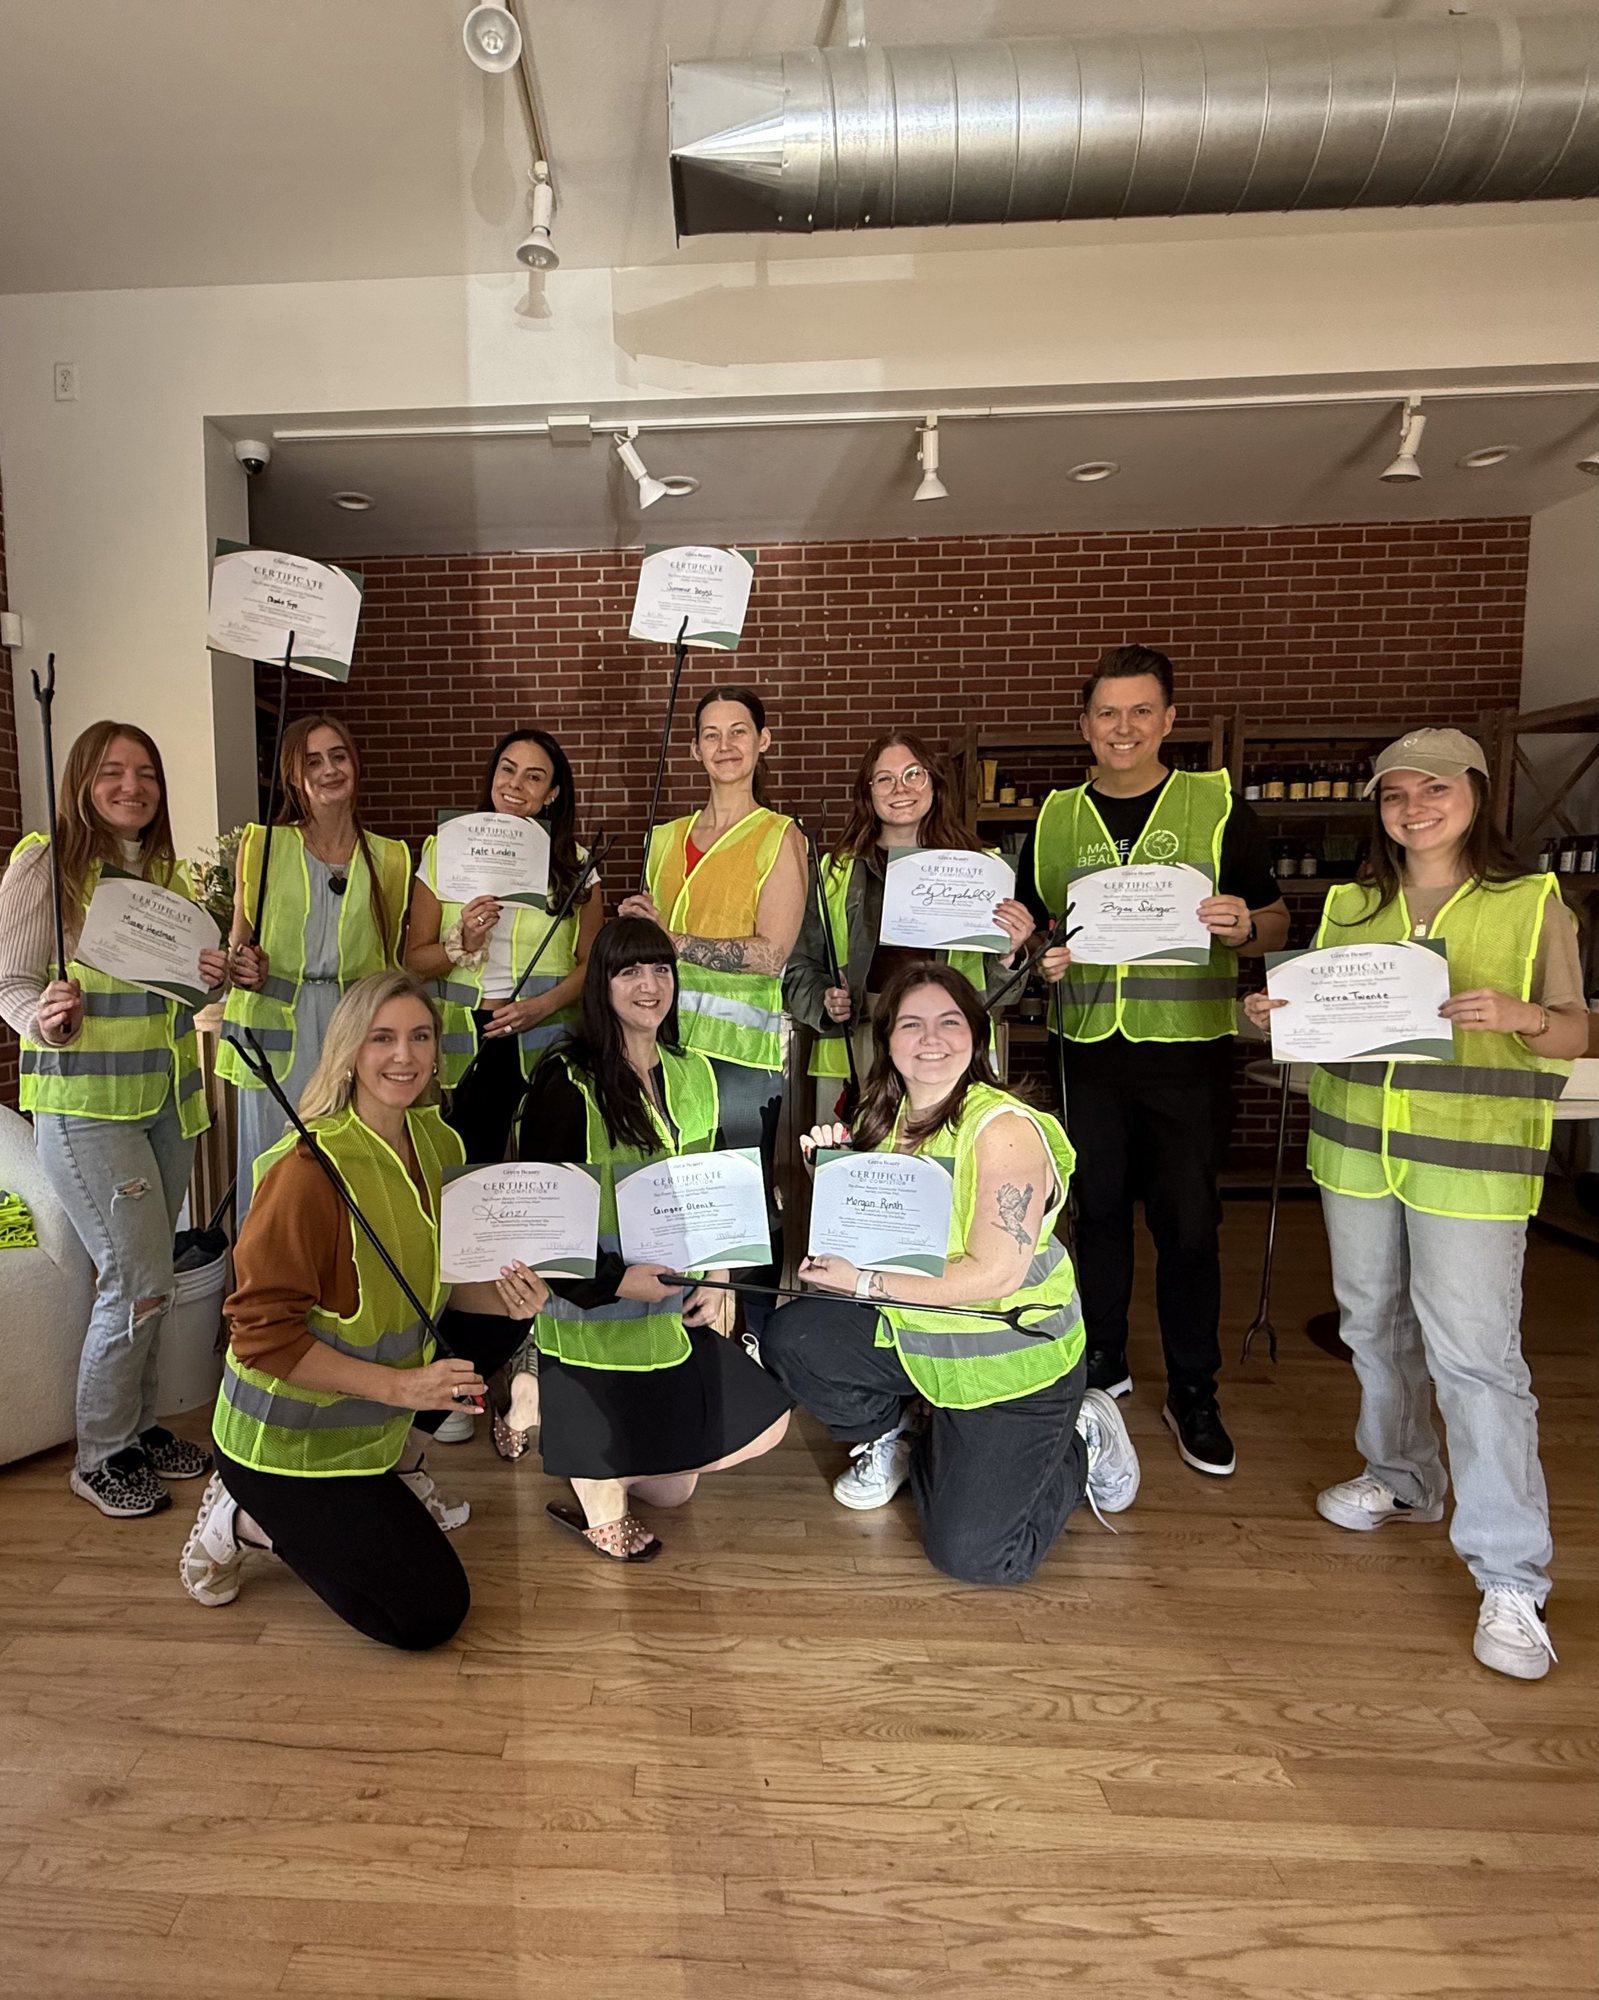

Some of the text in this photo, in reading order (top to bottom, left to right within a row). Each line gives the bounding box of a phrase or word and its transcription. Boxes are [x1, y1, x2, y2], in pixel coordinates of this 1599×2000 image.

[670, 561, 723, 573] CERTIFICATE
[254, 566, 324, 590] CERTIFICATE
[468, 826, 523, 838] CERTIFICATE
[1079, 839, 1130, 855] I MAKE
[921, 865, 984, 876] CERTIFICATE
[1104, 881, 1173, 890] CERTIFICATE
[132, 893, 193, 923] CERTIFICATE
[1310, 961, 1397, 976] CERTIFICATE
[1313, 993, 1348, 1003] Cierra
[653, 1170, 723, 1186] CERTIFICATE
[850, 1170, 917, 1183] CERTIFICATE
[483, 1181, 559, 1191] CERTIFICATE
[846, 1196, 875, 1211] Morgan
[653, 1206, 684, 1215] Ginger
